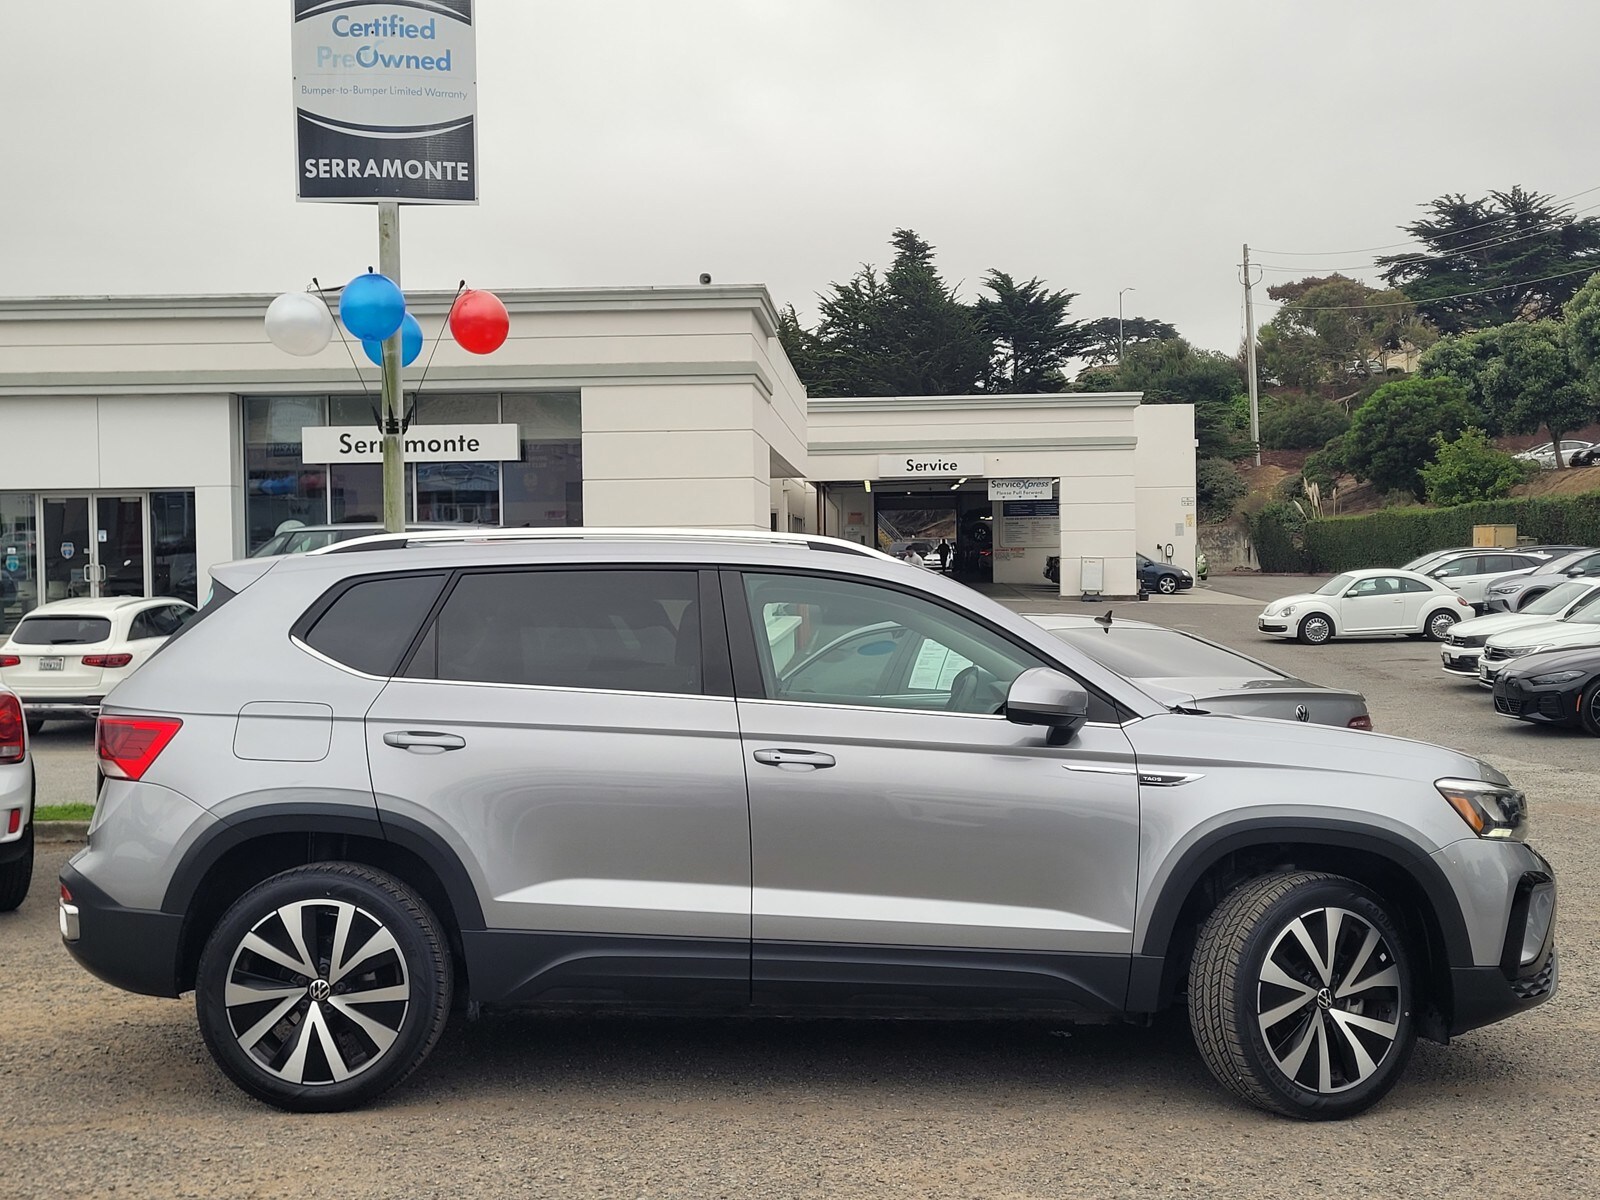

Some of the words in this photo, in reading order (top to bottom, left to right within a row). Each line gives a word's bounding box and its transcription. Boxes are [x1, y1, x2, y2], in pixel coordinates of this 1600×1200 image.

[332, 14, 436, 39] Certified
[301, 85, 387, 96] Bumper-to-Bumper
[389, 86, 423, 97] Limited
[424, 87, 468, 100] Warranty
[304, 159, 469, 181] SERRAMONTE
[339, 433, 480, 454] Serrmonte
[905, 458, 958, 472] Service
